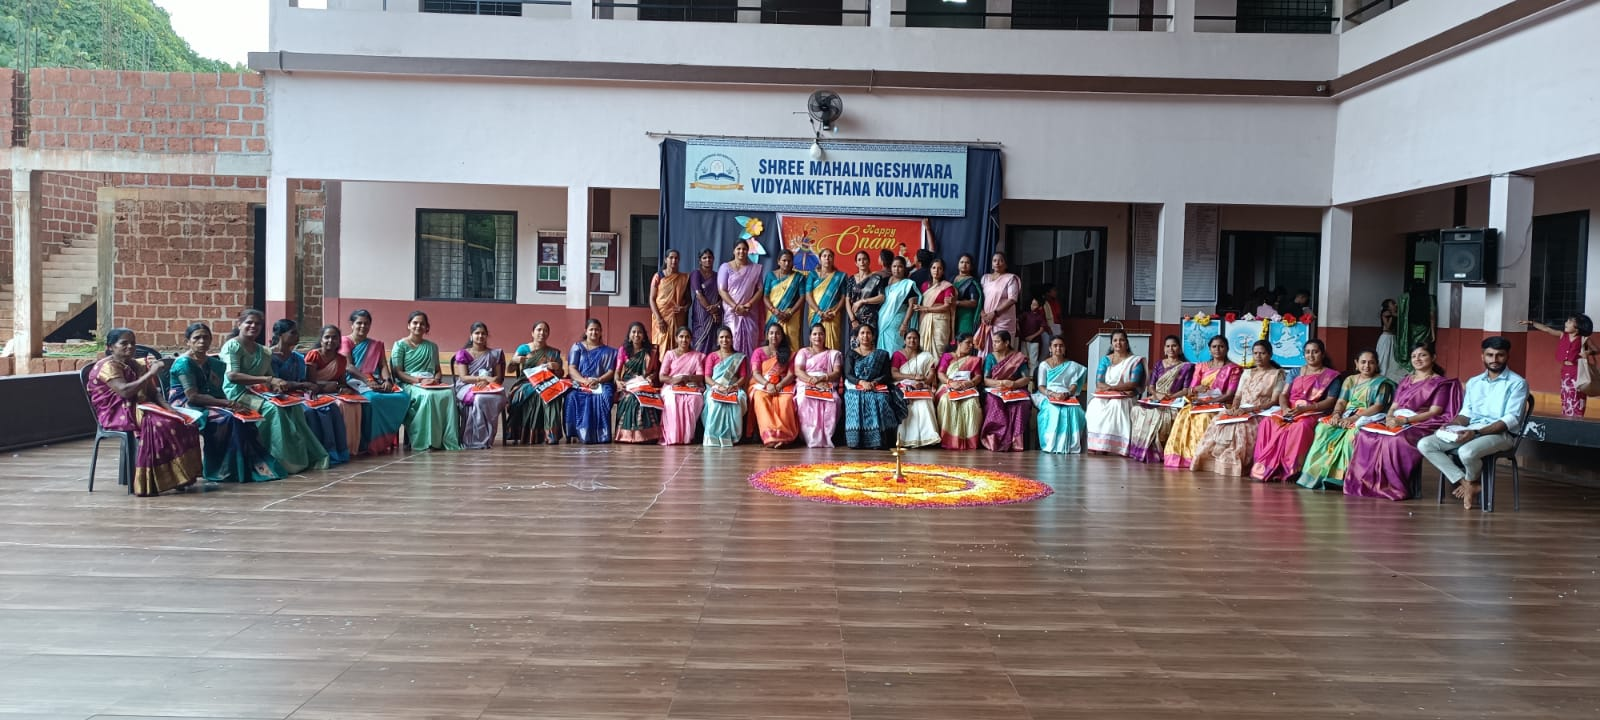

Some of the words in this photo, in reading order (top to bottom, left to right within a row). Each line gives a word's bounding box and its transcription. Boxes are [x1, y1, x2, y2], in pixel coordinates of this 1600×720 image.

[759, 159, 804, 175] SHREE
[810, 160, 952, 179] MAHALINGESHWARA
[751, 178, 870, 197] VIDYANIKETHANA
[876, 182, 959, 199] KUNJATHUR
[817, 225, 898, 256] Onam
[863, 224, 896, 237] Happy
